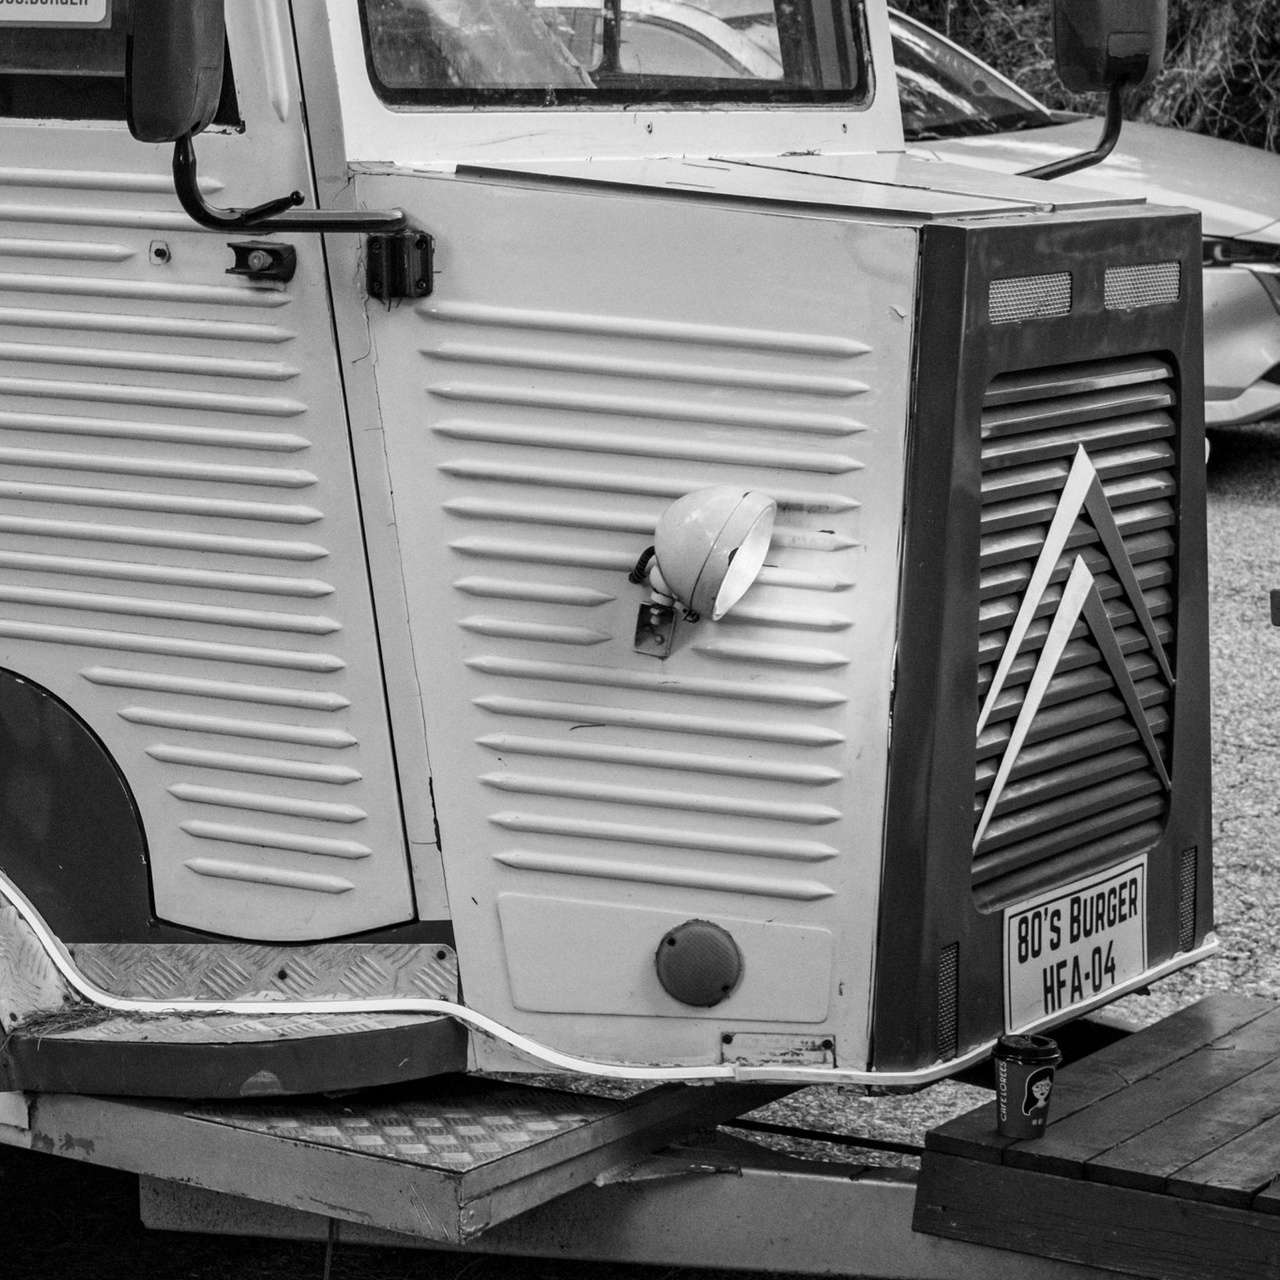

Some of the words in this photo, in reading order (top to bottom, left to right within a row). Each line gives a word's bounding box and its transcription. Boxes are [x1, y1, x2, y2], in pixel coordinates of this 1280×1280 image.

[1017, 907, 1062, 964] 80'S
[1070, 877, 1138, 945] BURGER
[1042, 939, 1116, 1016] HFA-04
